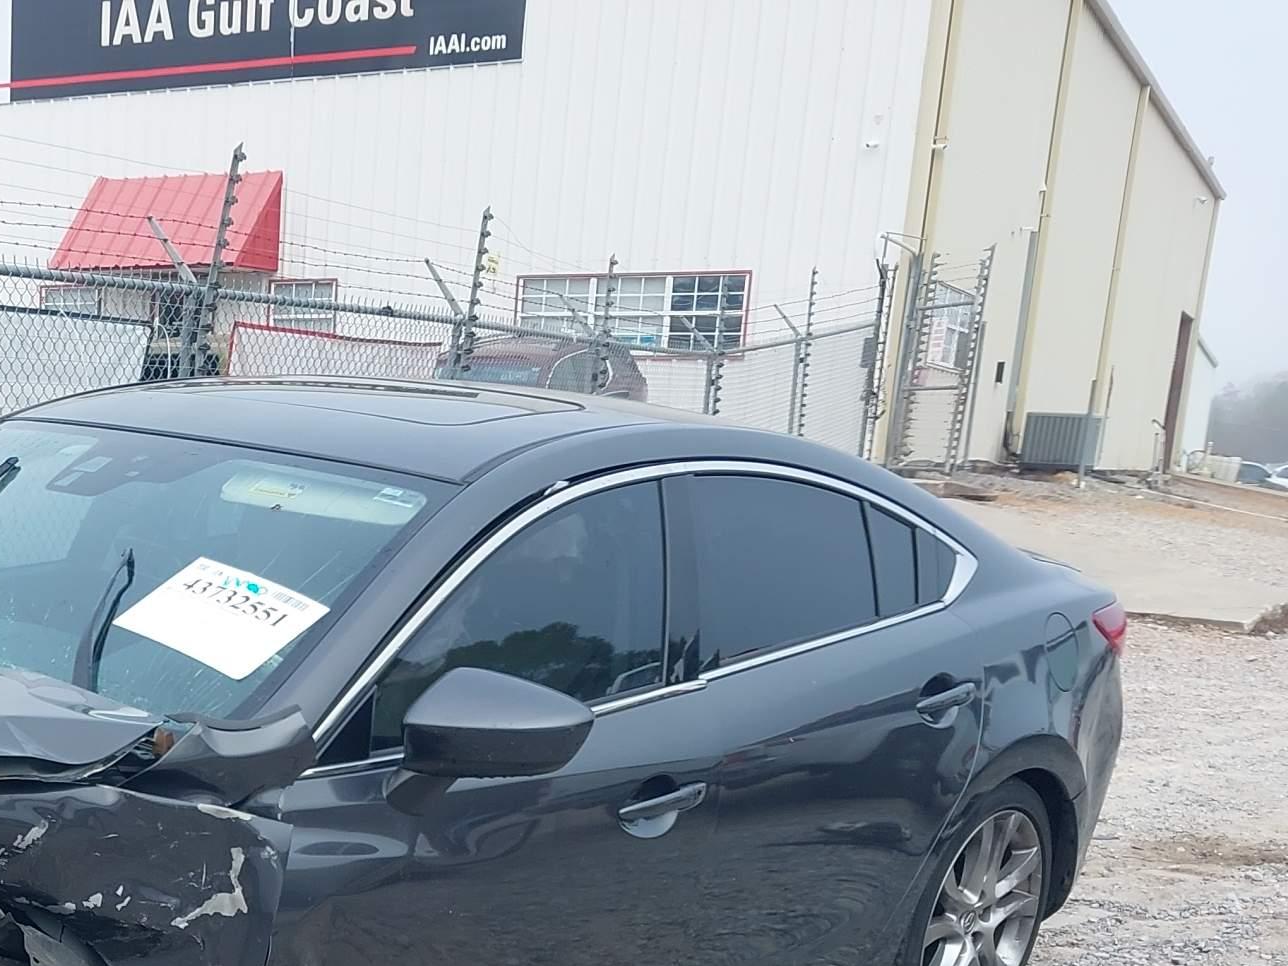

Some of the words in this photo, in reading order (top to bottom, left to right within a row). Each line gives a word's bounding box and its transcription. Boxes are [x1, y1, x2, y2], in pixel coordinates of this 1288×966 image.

[100, 0, 175, 47] IAA
[188, 0, 275, 38] Gulf
[427, 32, 506, 55] IAAI.com
[183, 577, 289, 627] 43732551
